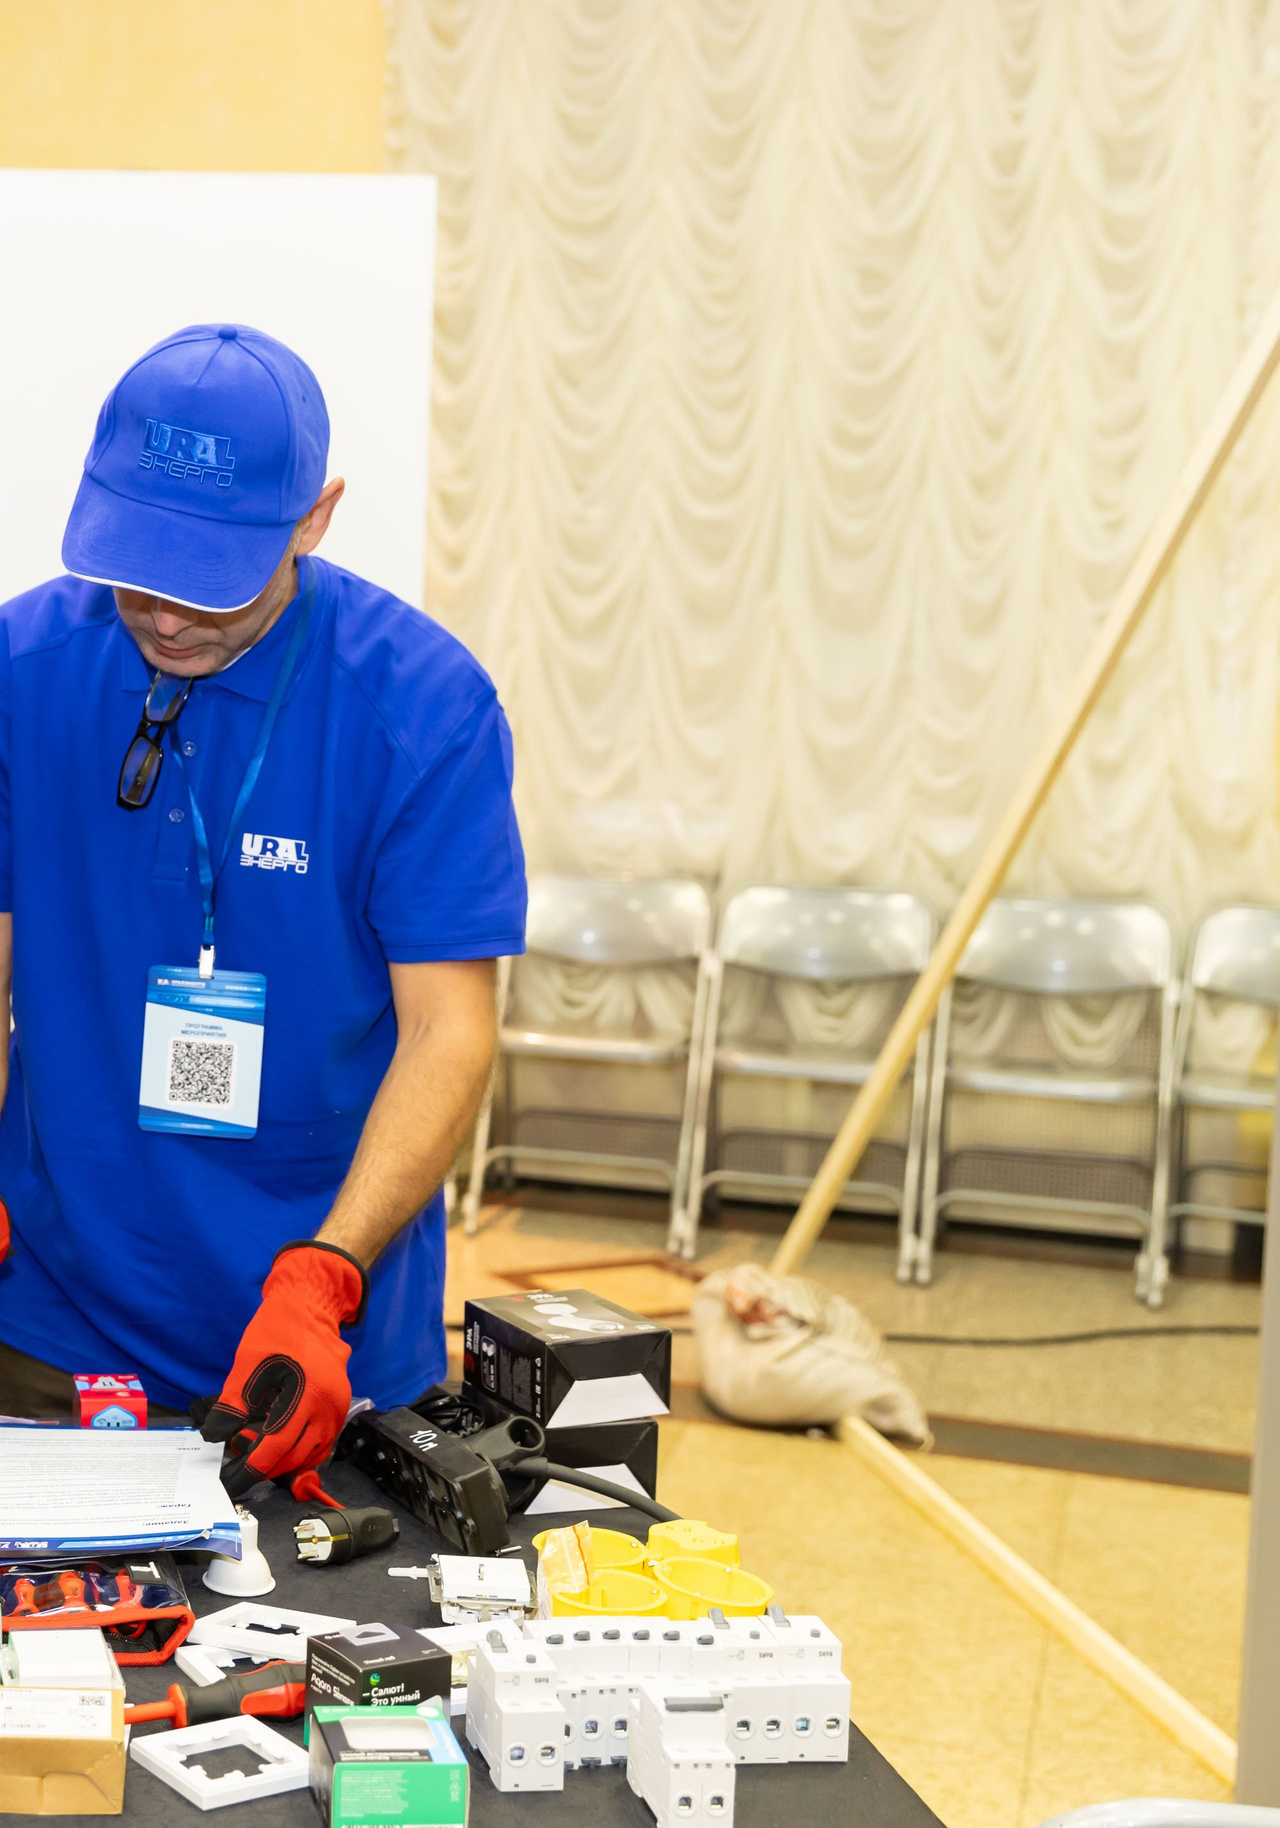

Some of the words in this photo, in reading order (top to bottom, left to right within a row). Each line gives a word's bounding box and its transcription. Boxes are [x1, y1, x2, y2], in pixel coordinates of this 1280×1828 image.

[144, 418, 236, 469] URAL
[138, 451, 233, 487] ЭНЕРГО
[241, 832, 309, 863] URAL
[240, 854, 308, 875] ЭНЕРГО
[181, 1029, 227, 1038] МЕРОПРИЯТИЯ
[185, 1022, 223, 1031] ПРОГРАММА
[758, 1651, 774, 1659] RoHS
[818, 1650, 833, 1658] RoHS
[371, 1682, 405, 1698] Салют!
[371, 1697, 390, 1706] Это
[390, 1689, 421, 1706] умный
